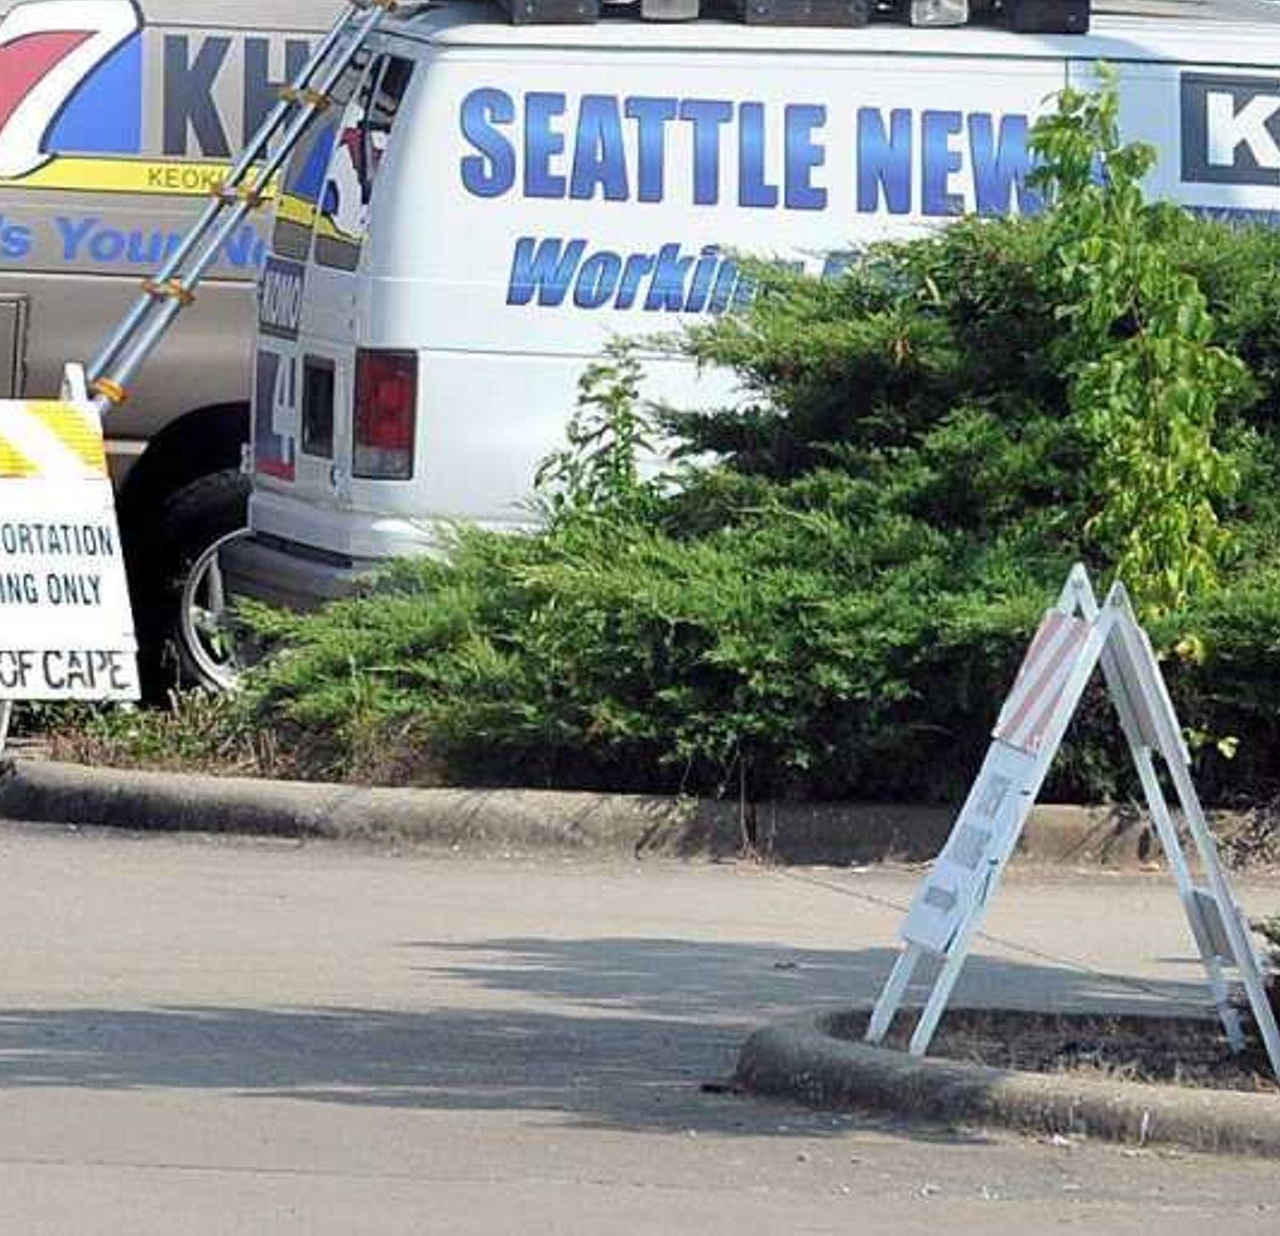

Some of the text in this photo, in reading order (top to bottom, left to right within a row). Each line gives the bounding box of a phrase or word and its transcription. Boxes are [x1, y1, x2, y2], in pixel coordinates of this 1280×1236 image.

[459, 86, 1112, 219] SEATTLE NEW
[46, 572, 103, 605] ONLY
[42, 650, 132, 690] CAPE
